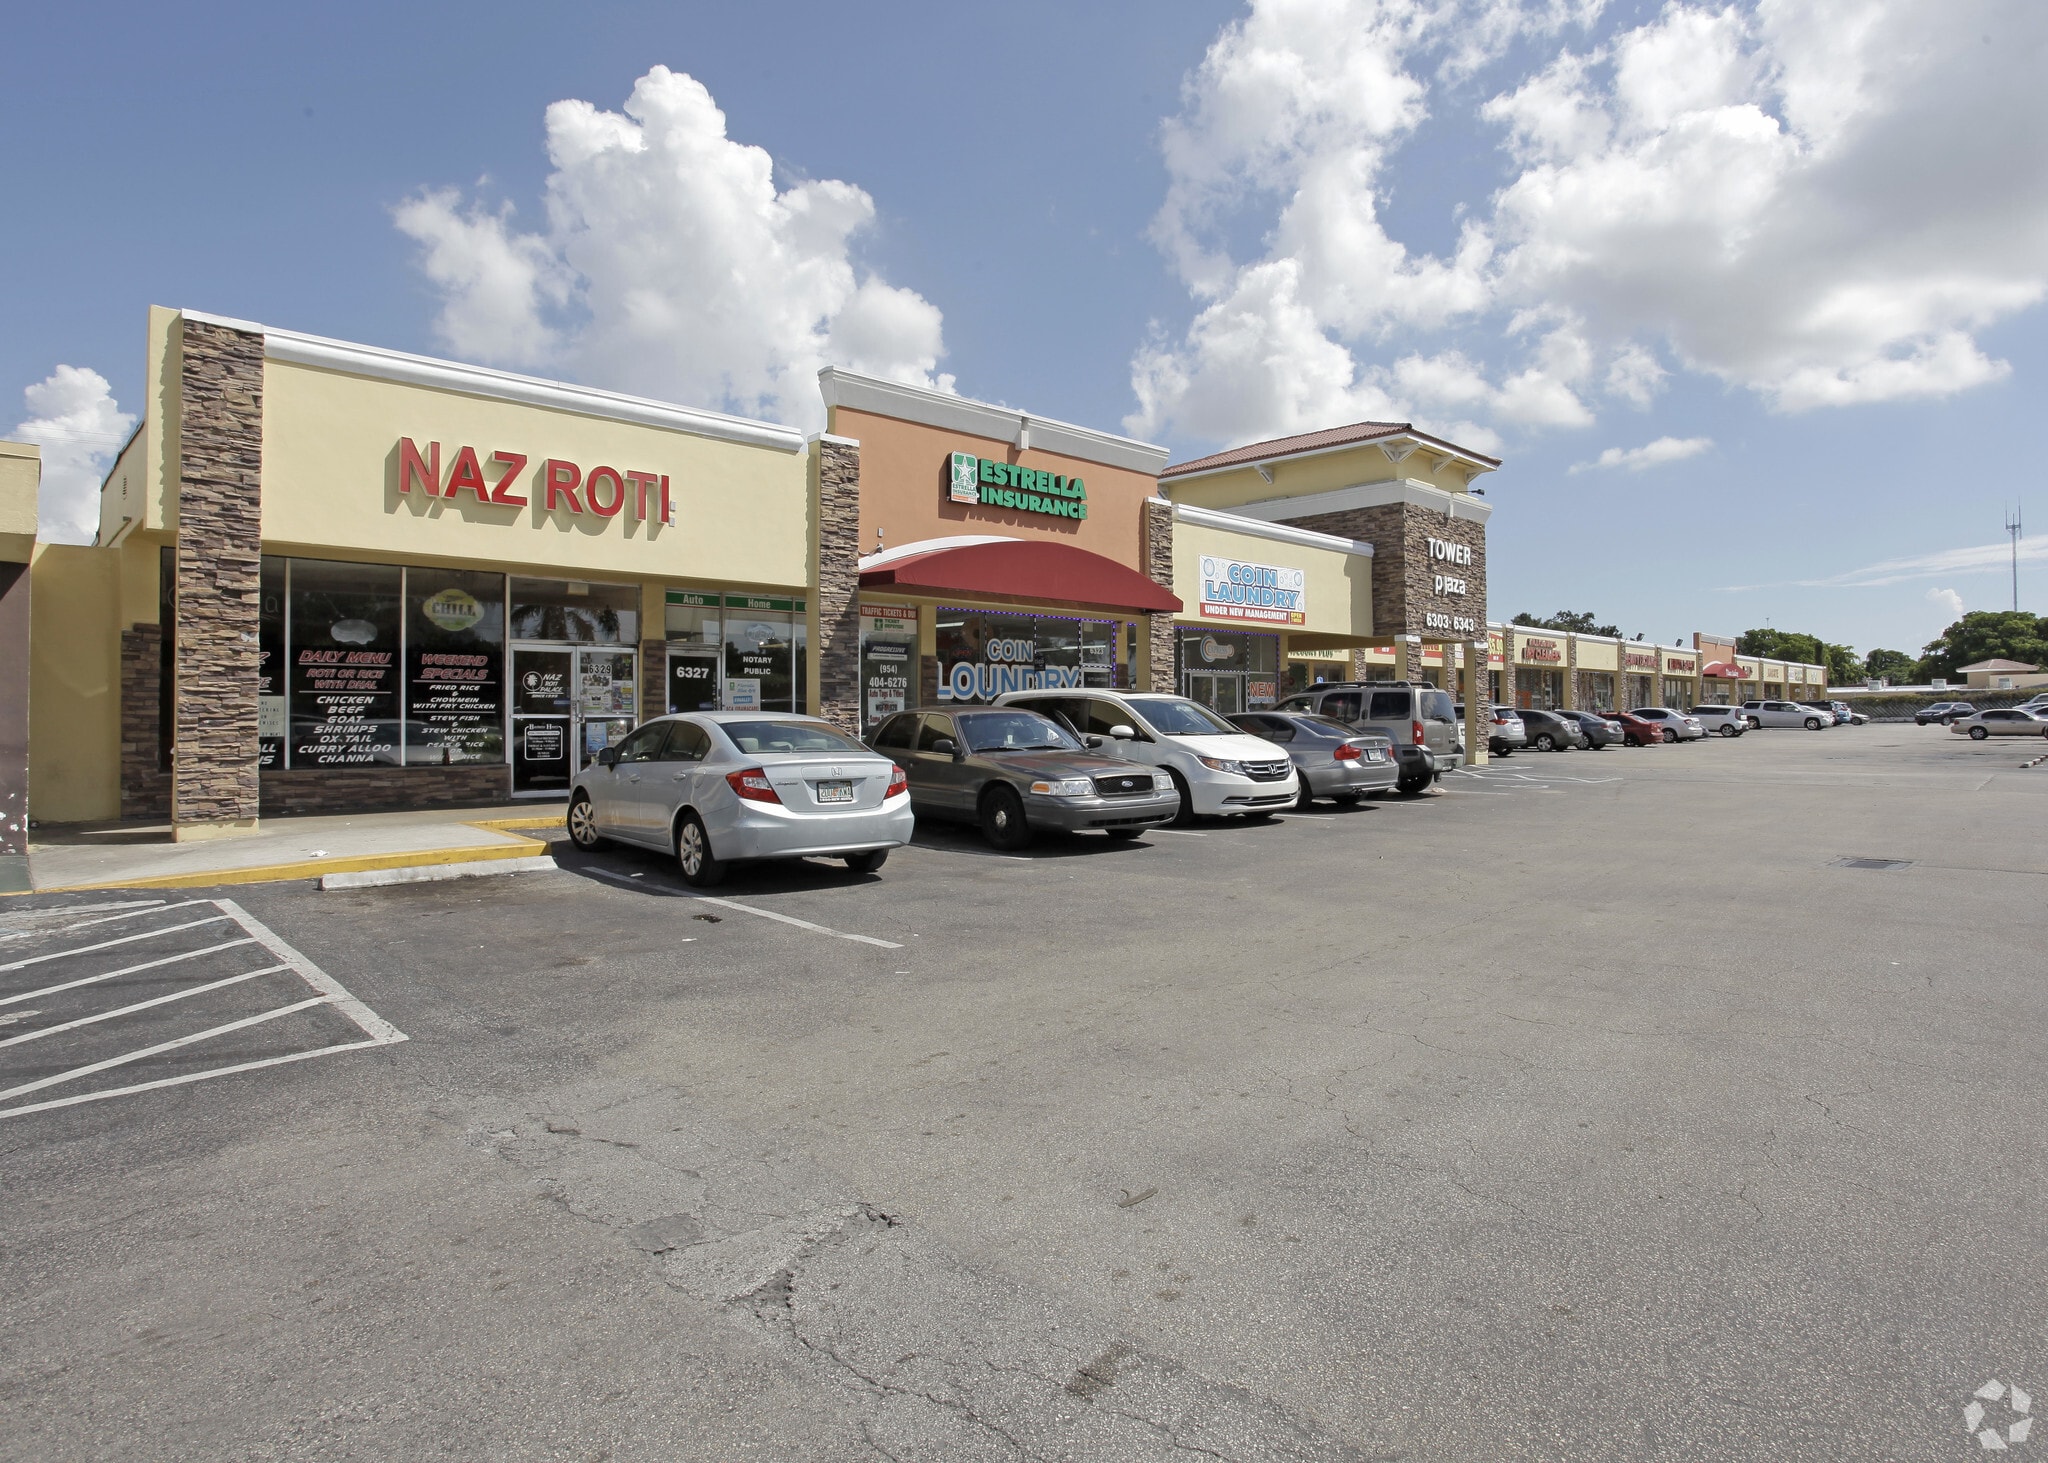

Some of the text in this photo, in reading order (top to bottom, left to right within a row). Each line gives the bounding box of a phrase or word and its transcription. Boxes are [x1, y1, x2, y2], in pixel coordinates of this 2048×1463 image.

[400, 436, 670, 523] NAZ ROTI
[979, 458, 1088, 501] ESTRELLA
[952, 483, 976, 492] ESTRELLA
[981, 486, 1088, 520] INSURANCE
[1427, 537, 1472, 566] TOWER
[1227, 563, 1278, 589] COIN
[1205, 580, 1300, 610] LAUNDRY
[683, 594, 771, 609] Auto Home
[861, 606, 882, 616] TRAFFIC
[883, 608, 902, 618] TICKETS
[1204, 604, 1287, 620] UNDER NEW MANAGEMENT
[1453, 617, 1474, 632] 6343
[986, 638, 1034, 662] COIN
[299, 650, 392, 664] DAILY MENU
[421, 653, 488, 667] WEEKEND
[742, 656, 772, 664] NOTARY
[306, 668, 384, 679] ROTI OR RICE
[421, 667, 488, 680] SPECIALS
[588, 664, 611, 674] 6329
[676, 666, 709, 679] 6327
[743, 667, 771, 675] PUBLIC
[880, 664, 897, 674] (954)
[543, 673, 563, 681] NAZ
[869, 677, 907, 688] 404-6276
[314, 680, 378, 690] WITH DHAL
[1248, 682, 1276, 697] NEW
[316, 696, 375, 704] CHICKEN
[327, 706, 365, 714] BEEF
[327, 715, 365, 724] GOAT
[313, 725, 378, 734] SHRIMPS
[320, 735, 372, 743] OX TAIL
[298, 744, 392, 754] CURRY ALLOO
[318, 754, 374, 763] CHANNA
